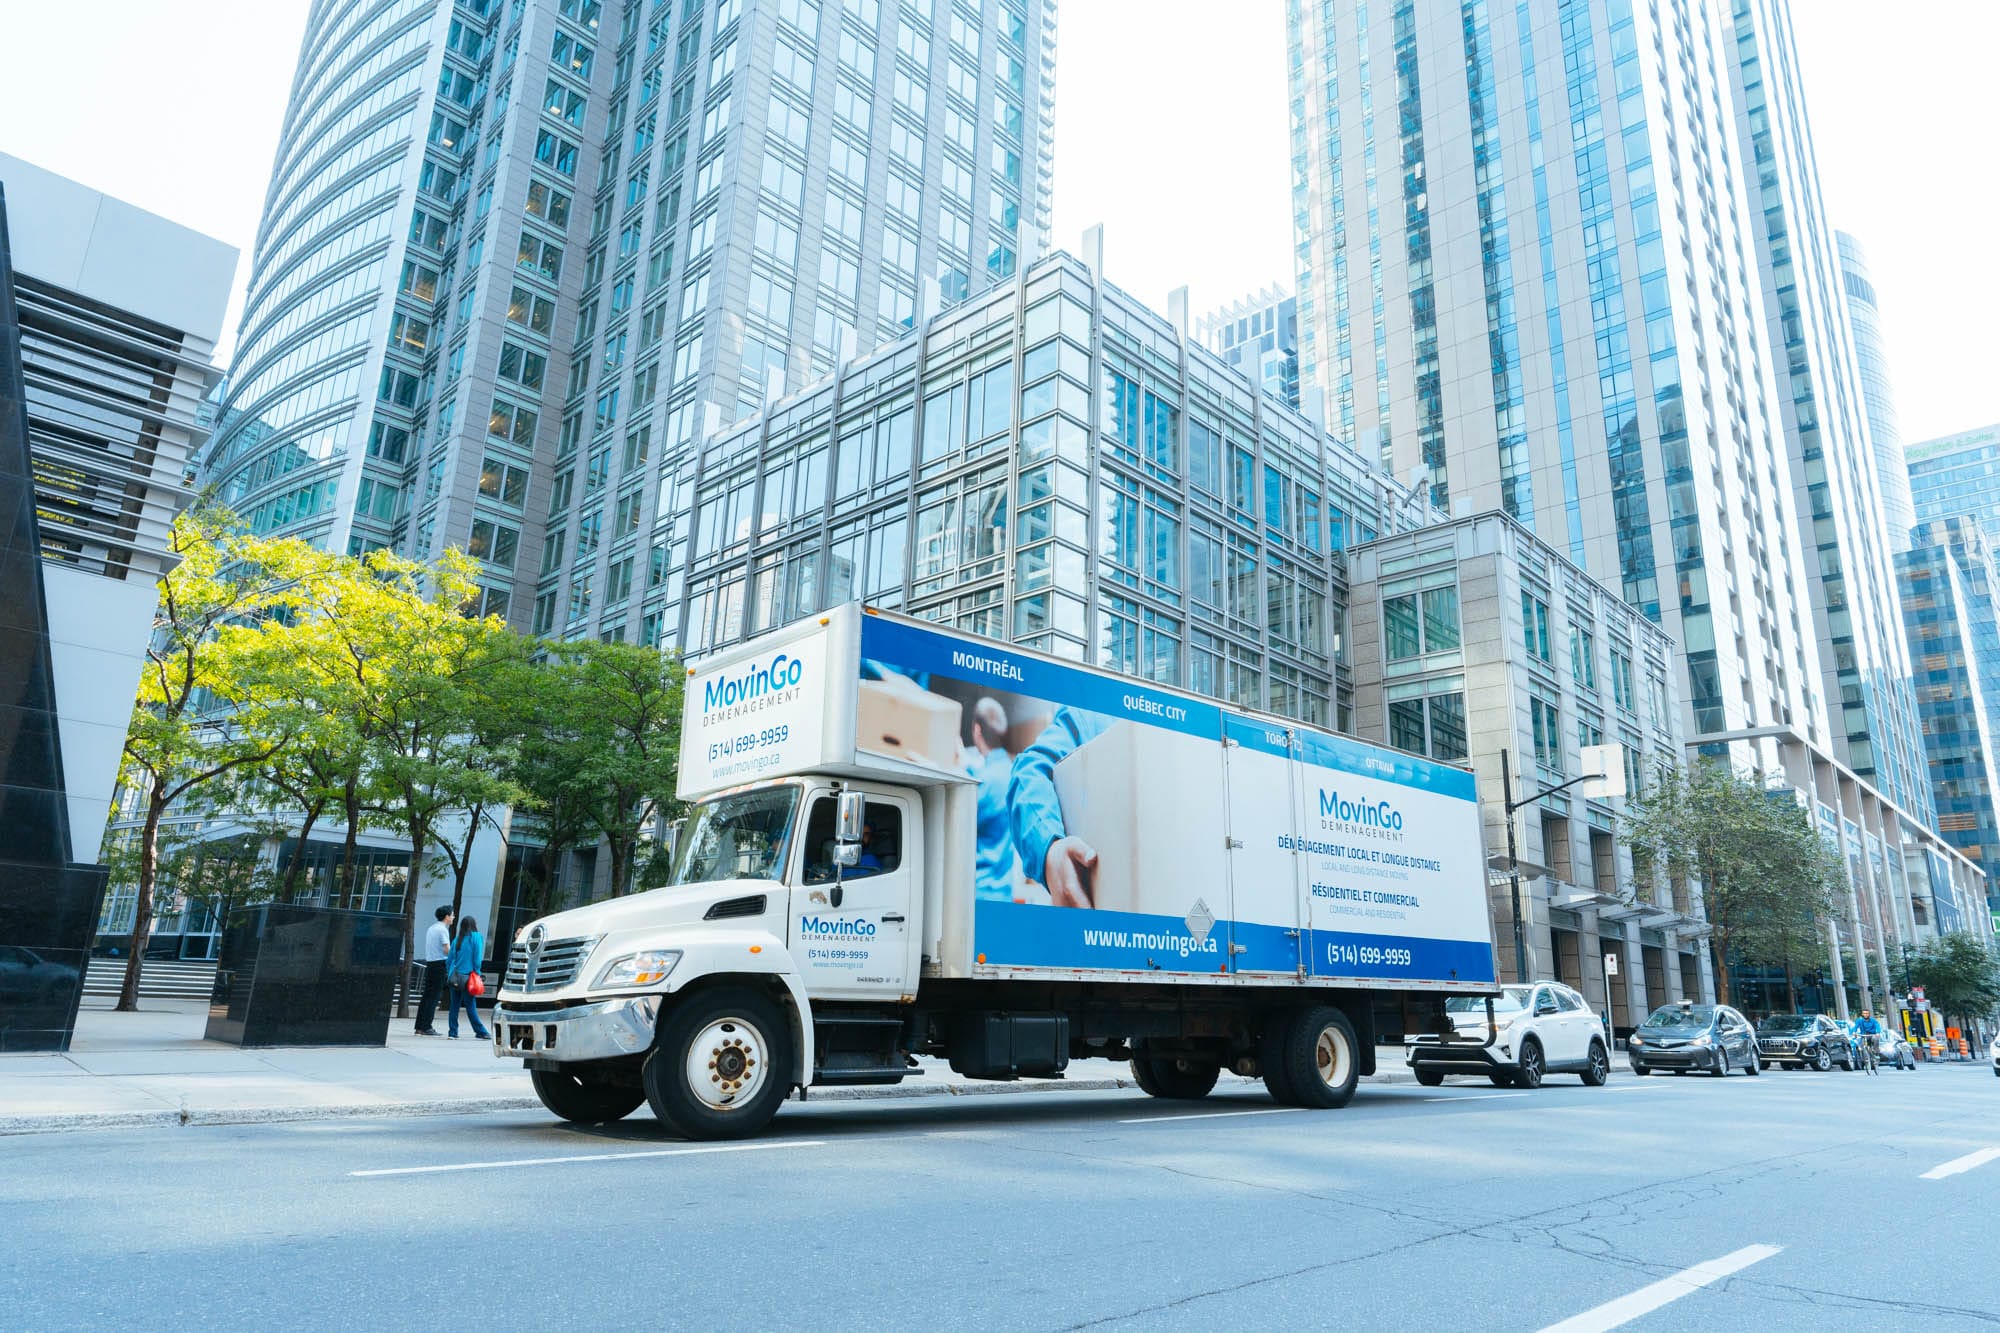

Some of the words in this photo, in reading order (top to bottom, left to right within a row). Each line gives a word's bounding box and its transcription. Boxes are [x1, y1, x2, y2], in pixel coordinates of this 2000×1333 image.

[953, 650, 1025, 682] MONTRÉAL
[704, 654, 802, 713] MovinGo
[703, 687, 801, 728] DEMENAGEMENT
[1123, 694, 1164, 717] QUÉBEC
[1166, 706, 1187, 722] CITY
[708, 738, 734, 763] (514)
[736, 724, 789, 753] 699-9959
[712, 751, 780, 779] www.movingo.ca
[1319, 788, 1403, 831] MovinGo
[1321, 820, 1404, 843] DEMENAGEMENT
[1347, 846, 1370, 861] LOCAL
[1371, 851, 1380, 863] ET
[1382, 852, 1409, 867] LONGUE
[1410, 857, 1441, 872] DISTANCE
[1312, 881, 1362, 902] RÉSIDENTIEL
[1363, 890, 1372, 902] ET
[1373, 891, 1420, 908] COMMERCIAL
[801, 934, 876, 942] DEMENAGEMENT
[802, 916, 876, 935] MovinGo
[808, 950, 829, 960] (514)
[831, 950, 869, 960] 699-9959
[1083, 929, 1218, 958] www.movingo.ca
[1327, 942, 1358, 966] (514)
[1359, 945, 1411, 966] 699-9959
